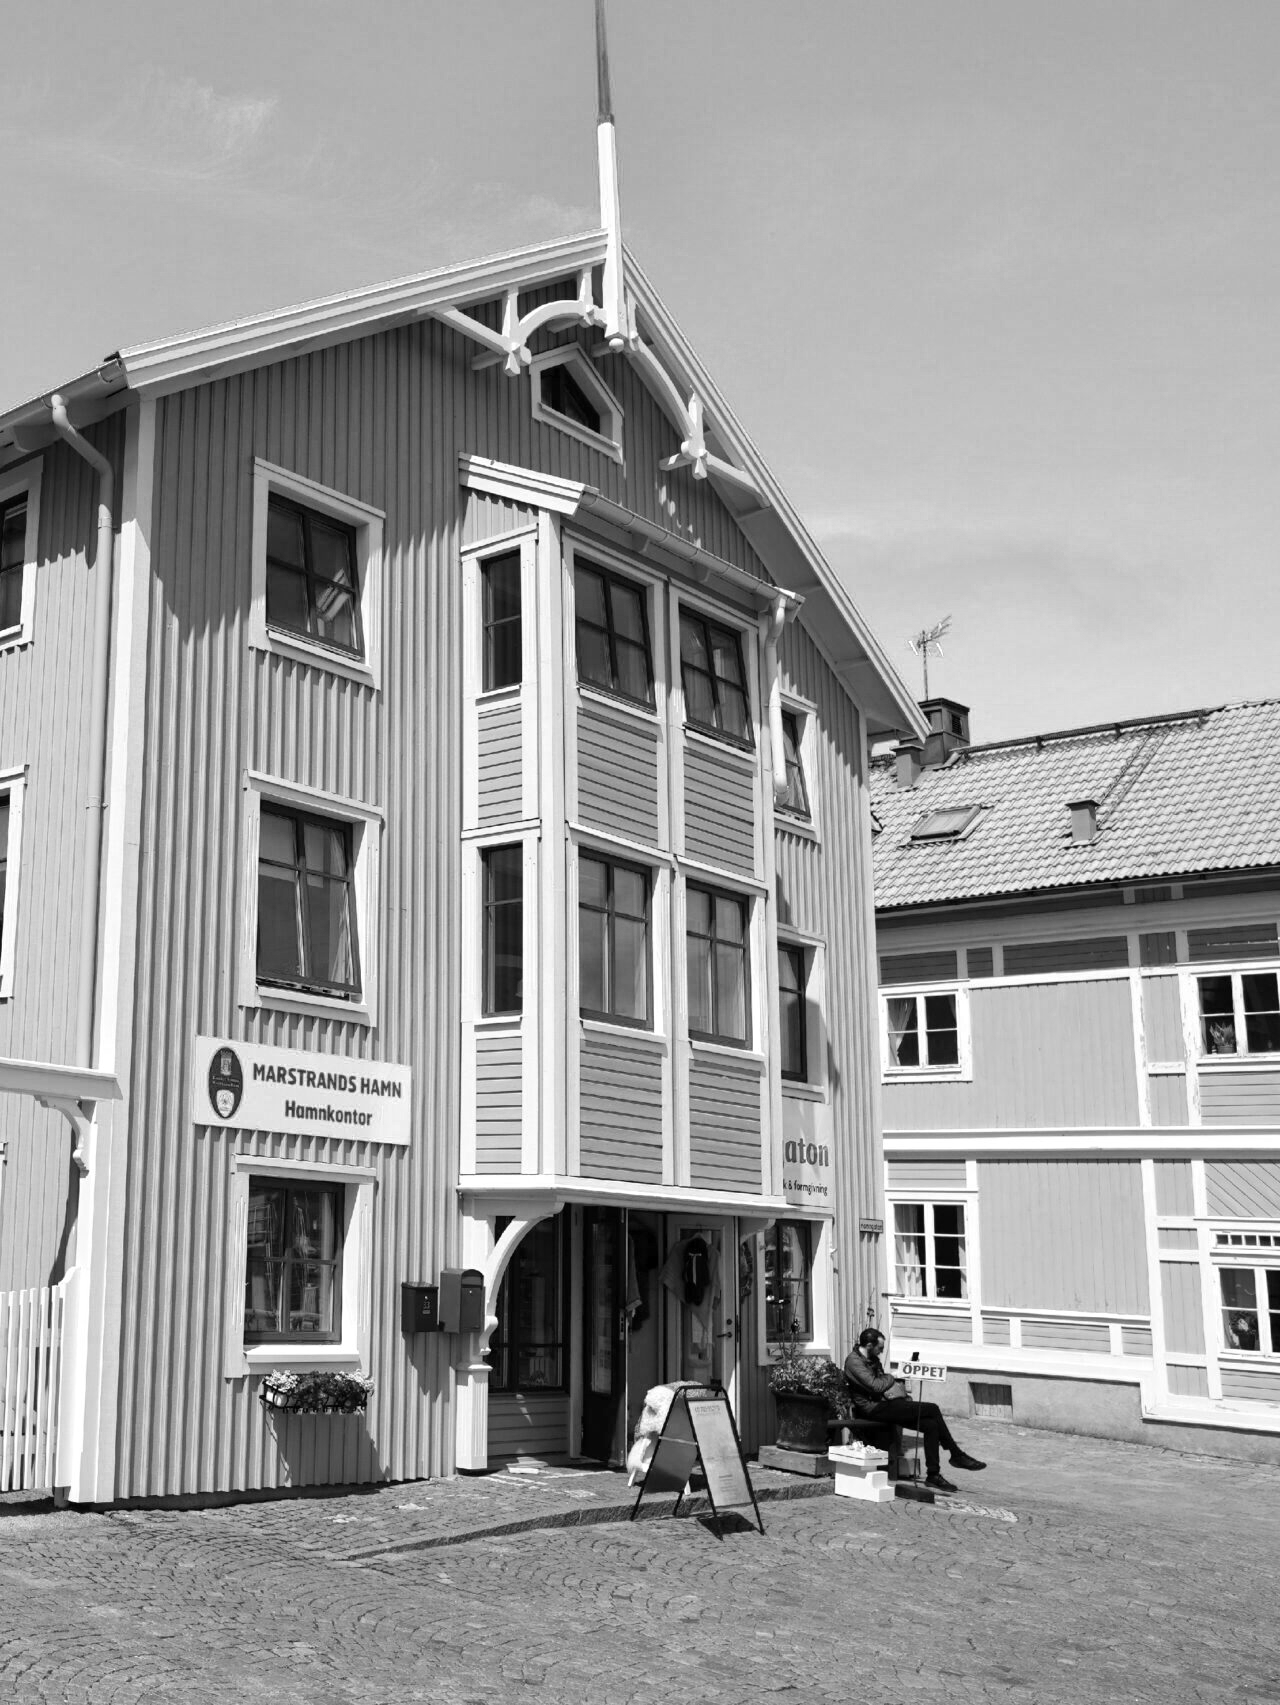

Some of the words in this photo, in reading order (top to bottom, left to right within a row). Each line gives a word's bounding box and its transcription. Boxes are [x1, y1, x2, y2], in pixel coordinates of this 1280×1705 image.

[253, 1063, 357, 1093] MARSTRANDS
[360, 1077, 402, 1099] HAMN
[285, 1099, 373, 1126] Hamnkontor
[782, 1138, 829, 1167] aton
[793, 1180, 828, 1197] formgivning
[902, 1362, 945, 1378] ÖPPET
